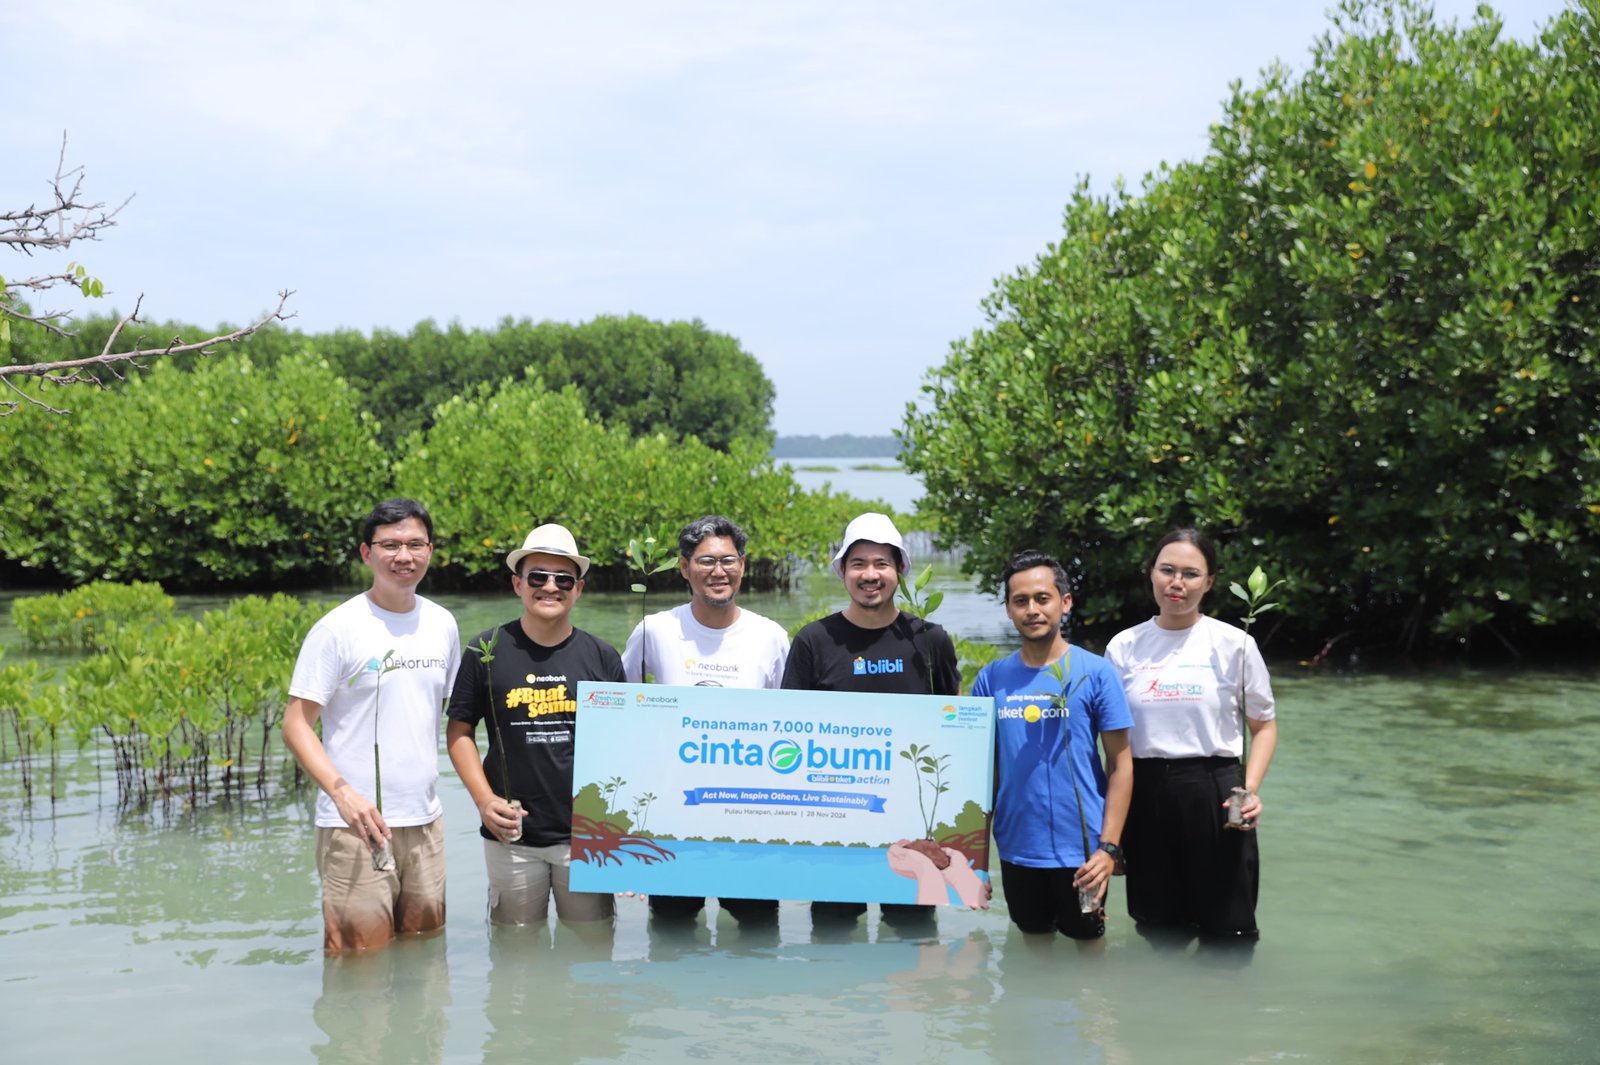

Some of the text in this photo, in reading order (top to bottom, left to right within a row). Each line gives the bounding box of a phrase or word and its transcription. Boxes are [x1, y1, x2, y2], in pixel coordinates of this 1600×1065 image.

[697, 663, 739, 672] neobank
[867, 659, 904, 674] blibli
[506, 684, 567, 708] #Buat
[646, 696, 678, 704] neobank
[528, 700, 576, 718] semu
[682, 716, 892, 738] Penanaman 7,000 Mangrove
[679, 734, 892, 771] cinta bumi
[857, 776, 890, 784] action
[702, 791, 869, 806] Act Now, Inspire Others, Live Sustainably
[744, 808, 772, 816] Harapan,
